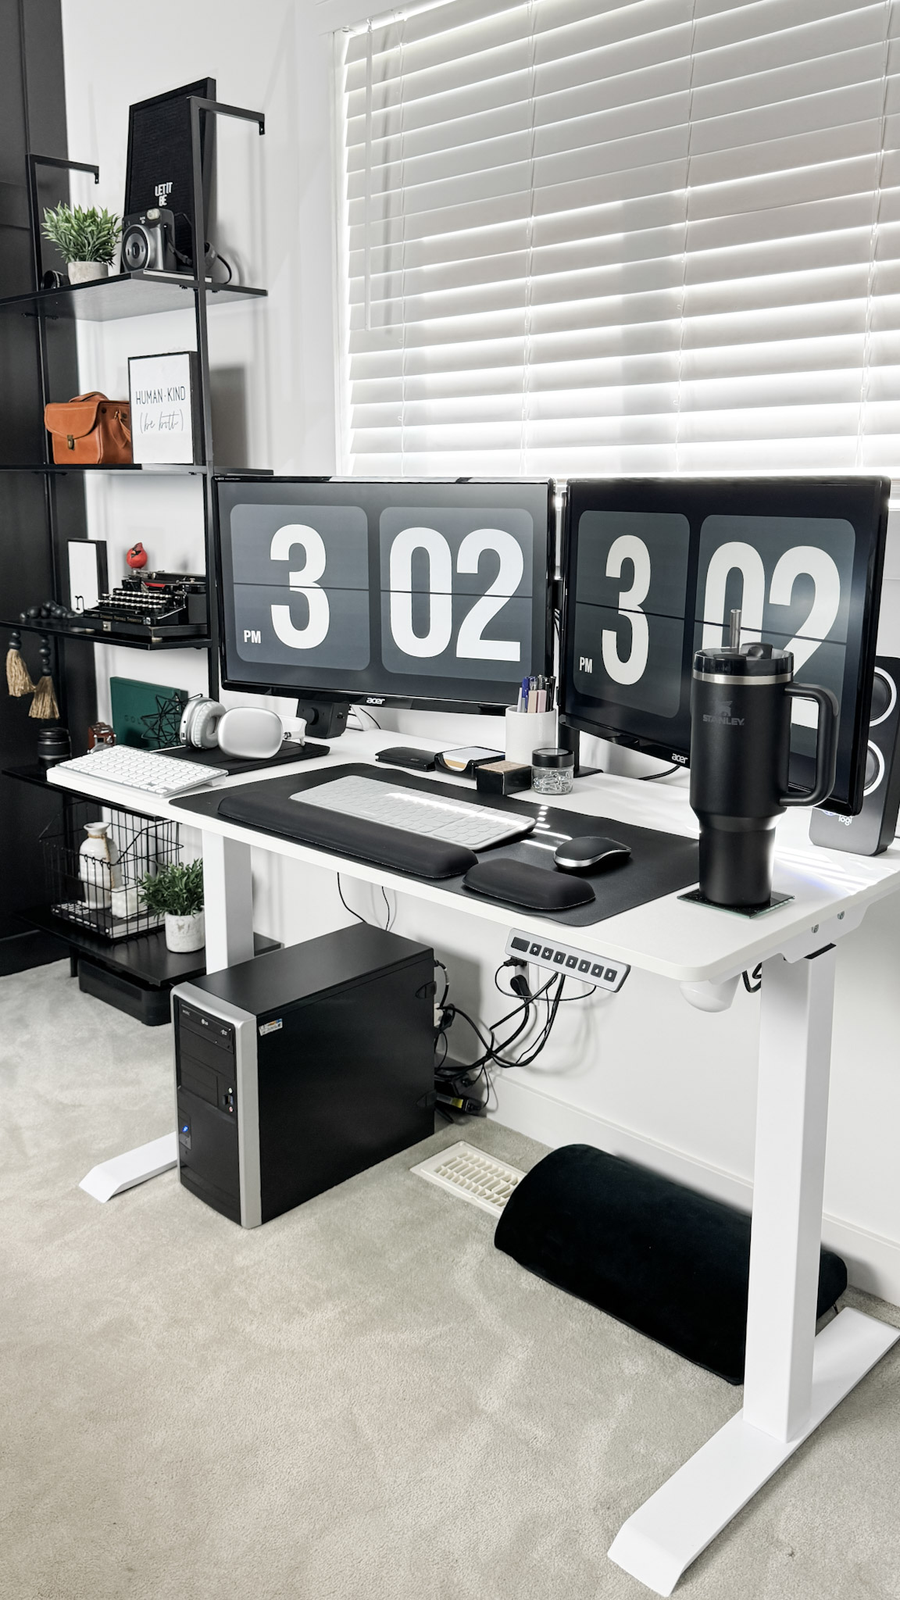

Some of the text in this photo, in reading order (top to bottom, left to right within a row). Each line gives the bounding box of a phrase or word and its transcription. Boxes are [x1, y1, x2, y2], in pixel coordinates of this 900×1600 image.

[154, 182, 173, 197] LET IT
[158, 194, 168, 207] BE
[270, 524, 524, 662] 3 02
[601, 534, 651, 685] 3
[243, 629, 262, 644] PM
[579, 656, 593, 674] PM
[366, 696, 386, 705] acer
[702, 714, 745, 726] STANLEY
[671, 752, 689, 764] acer
